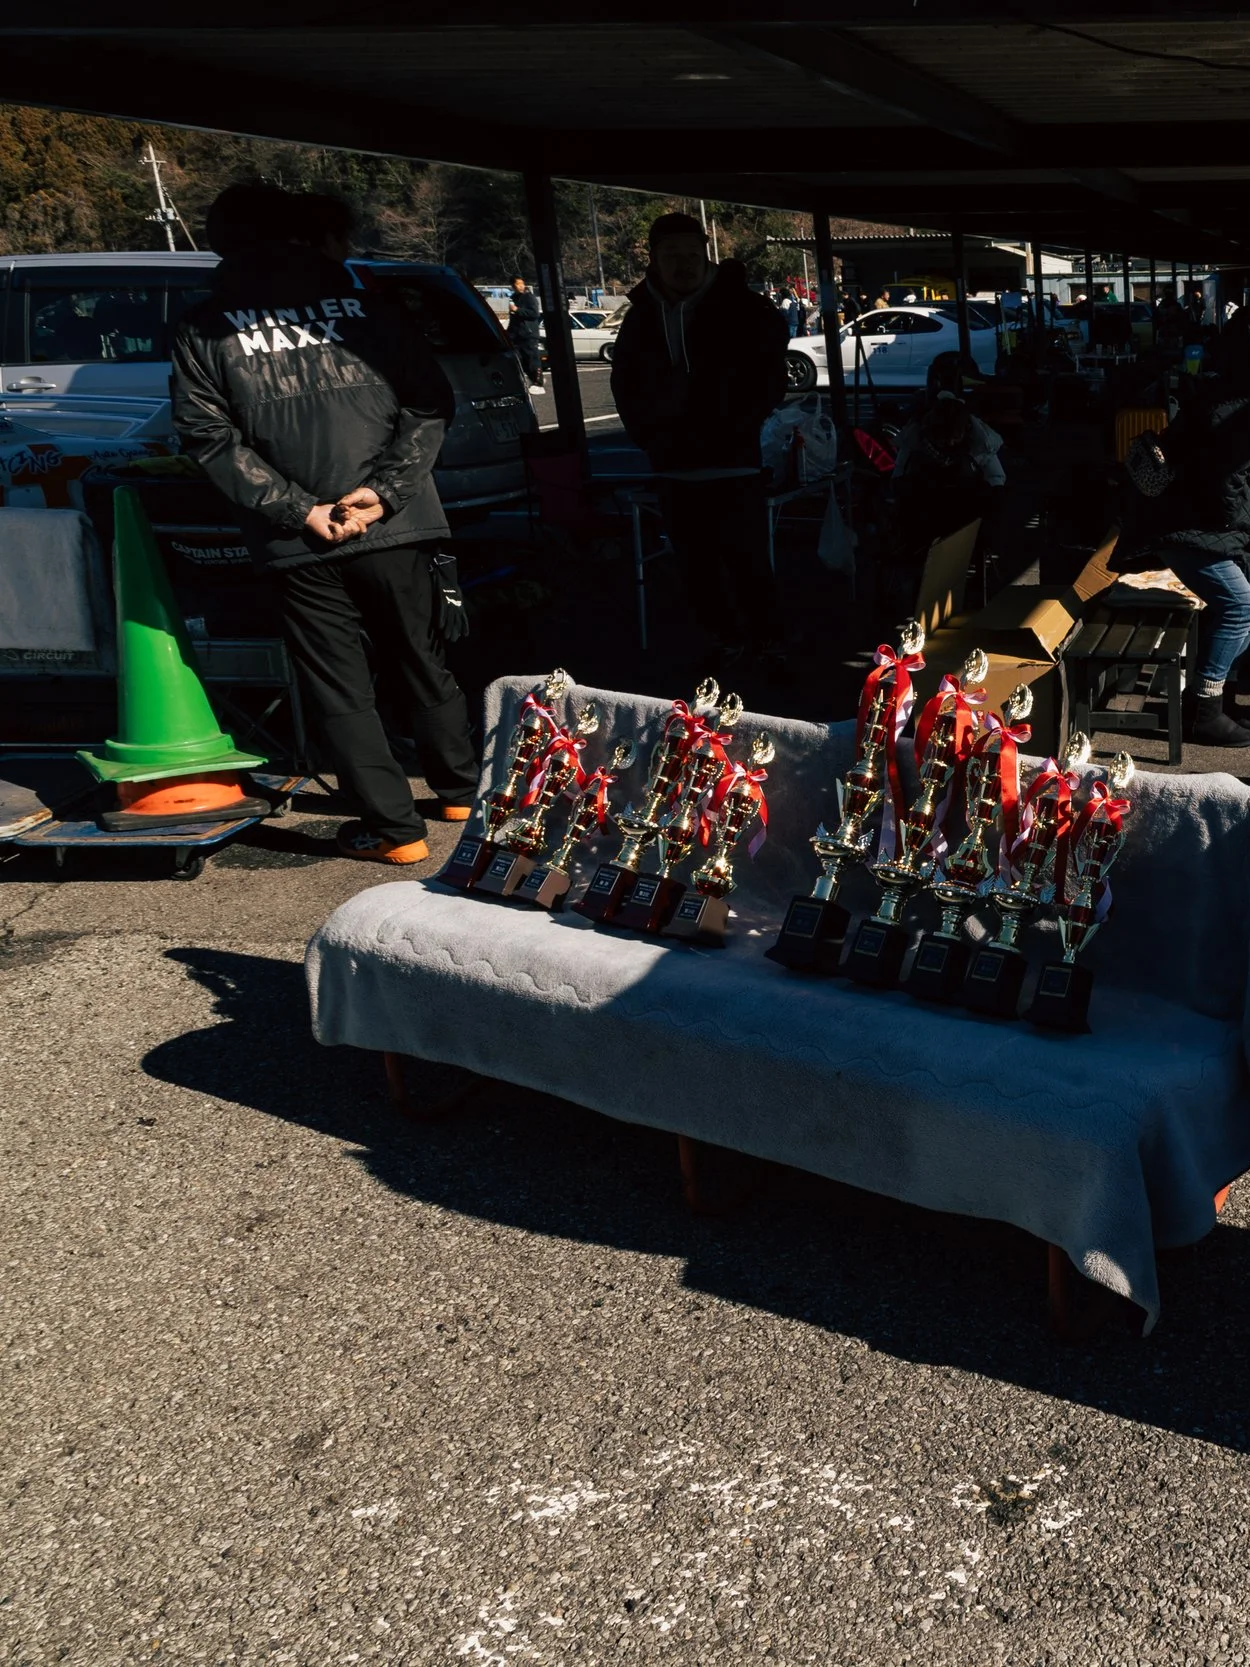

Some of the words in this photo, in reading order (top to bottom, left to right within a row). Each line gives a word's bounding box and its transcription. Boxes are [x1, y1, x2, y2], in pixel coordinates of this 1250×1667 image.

[237, 319, 344, 356] MAXX
[224, 546, 250, 558] STA
[23, 652, 76, 661] CIRCUIT
